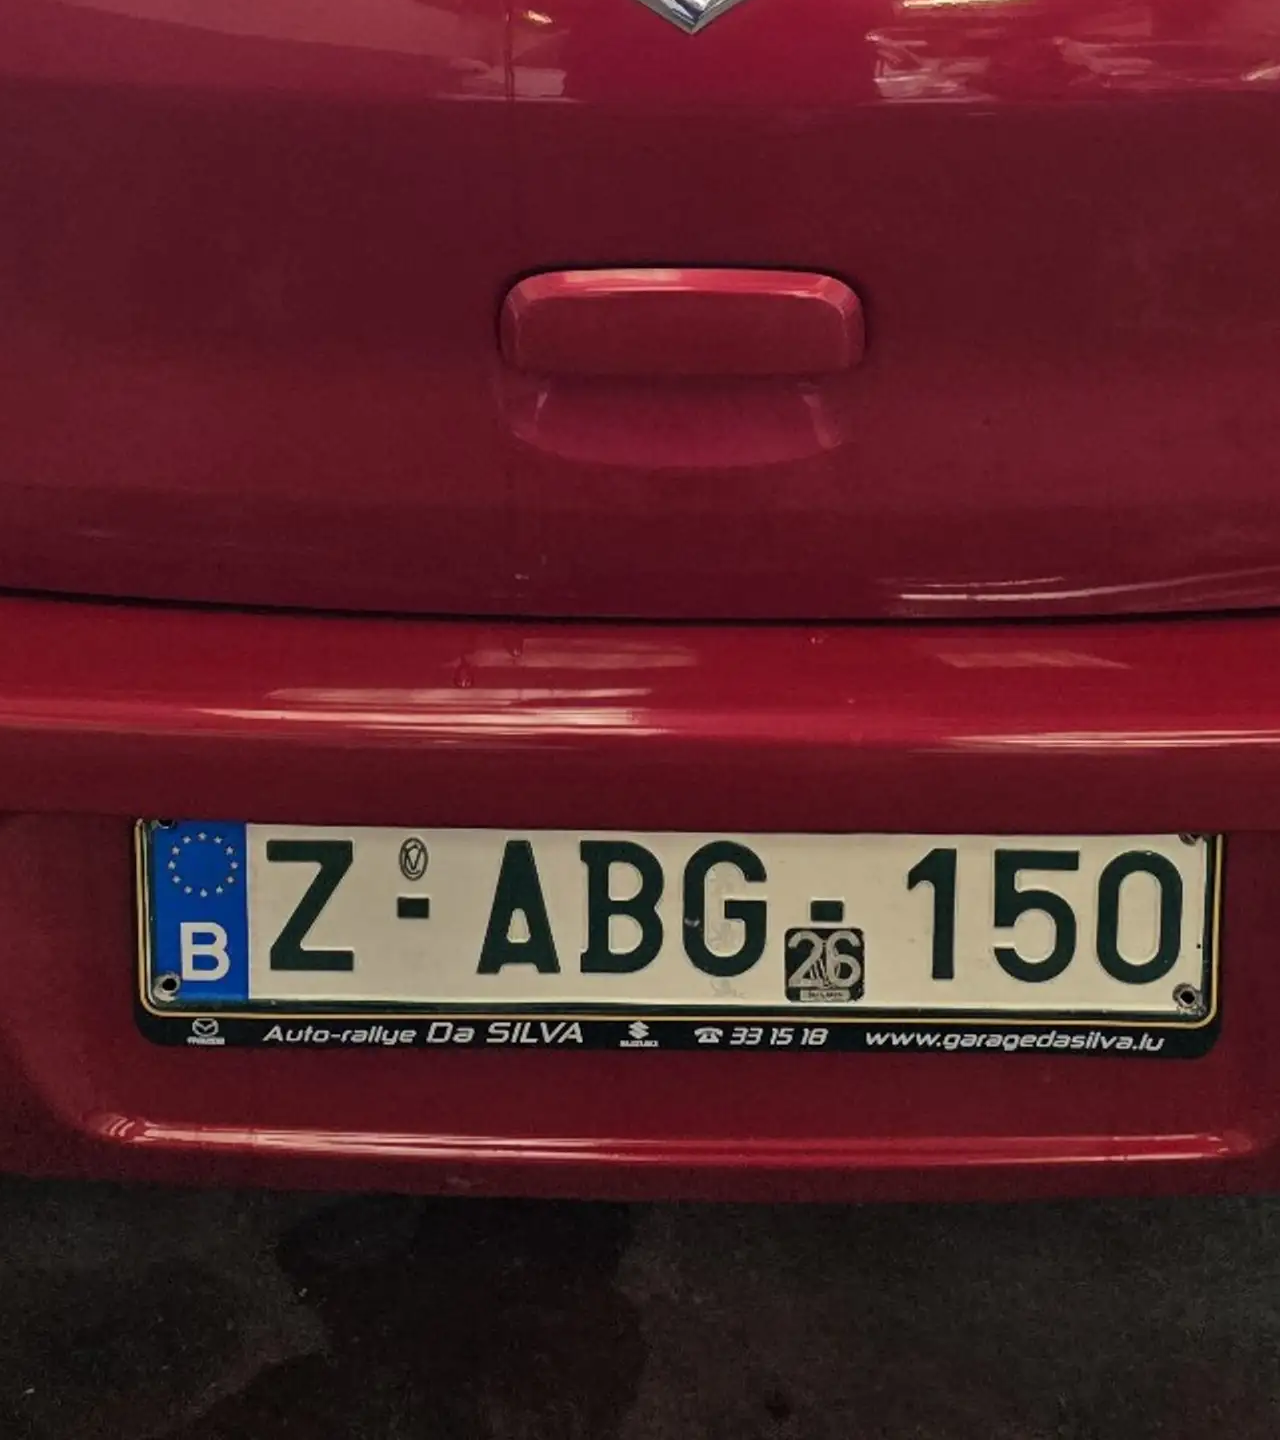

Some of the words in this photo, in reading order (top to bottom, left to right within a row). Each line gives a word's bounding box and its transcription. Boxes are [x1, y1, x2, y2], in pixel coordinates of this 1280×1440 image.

[179, 922, 231, 981] B
[263, 1025, 417, 1046] Auto-rallye
[426, 1022, 475, 1043] Da
[486, 1022, 584, 1044] SILVA
[730, 1027, 763, 1046] 33
[769, 1027, 794, 1046] 15
[799, 1027, 830, 1047] 18
[865, 1030, 1166, 1052] www.garagedasilva.lu
